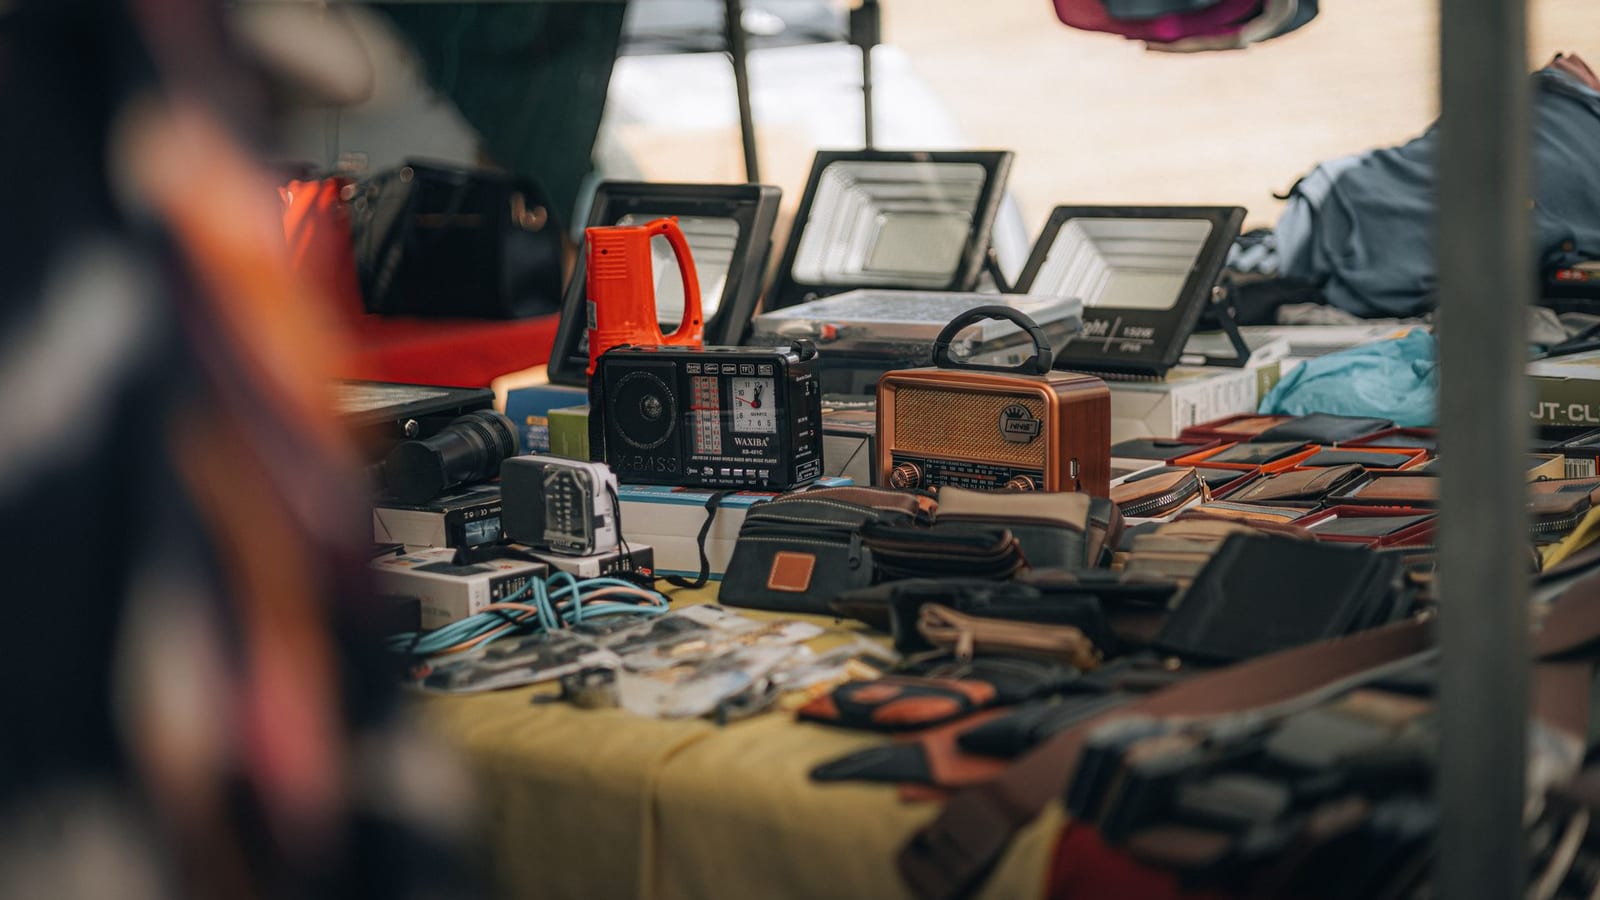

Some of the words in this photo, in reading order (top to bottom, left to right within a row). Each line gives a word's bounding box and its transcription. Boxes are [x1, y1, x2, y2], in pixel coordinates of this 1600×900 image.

[1529, 402, 1600, 422] JT-CL
[734, 437, 768, 447] WAXIBA
[617, 455, 677, 473] X-BASS
